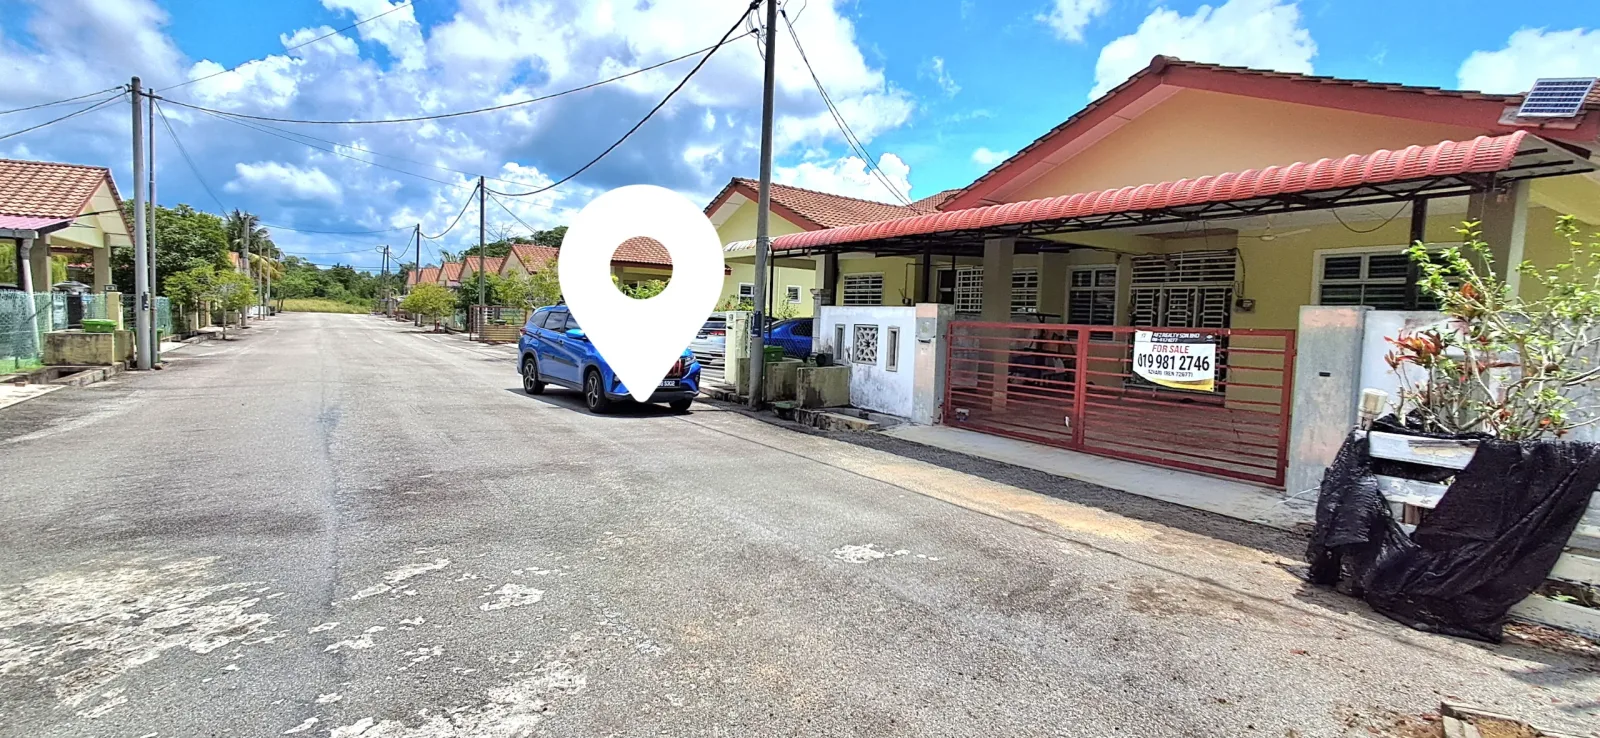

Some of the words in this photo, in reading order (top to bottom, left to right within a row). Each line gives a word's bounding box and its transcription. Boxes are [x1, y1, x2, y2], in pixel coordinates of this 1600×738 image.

[1152, 344, 1168, 353] FOR
[1169, 345, 1190, 354] SALE
[1138, 353, 1154, 368] 019
[1155, 354, 1175, 370] 981
[1179, 355, 1210, 371] 2746
